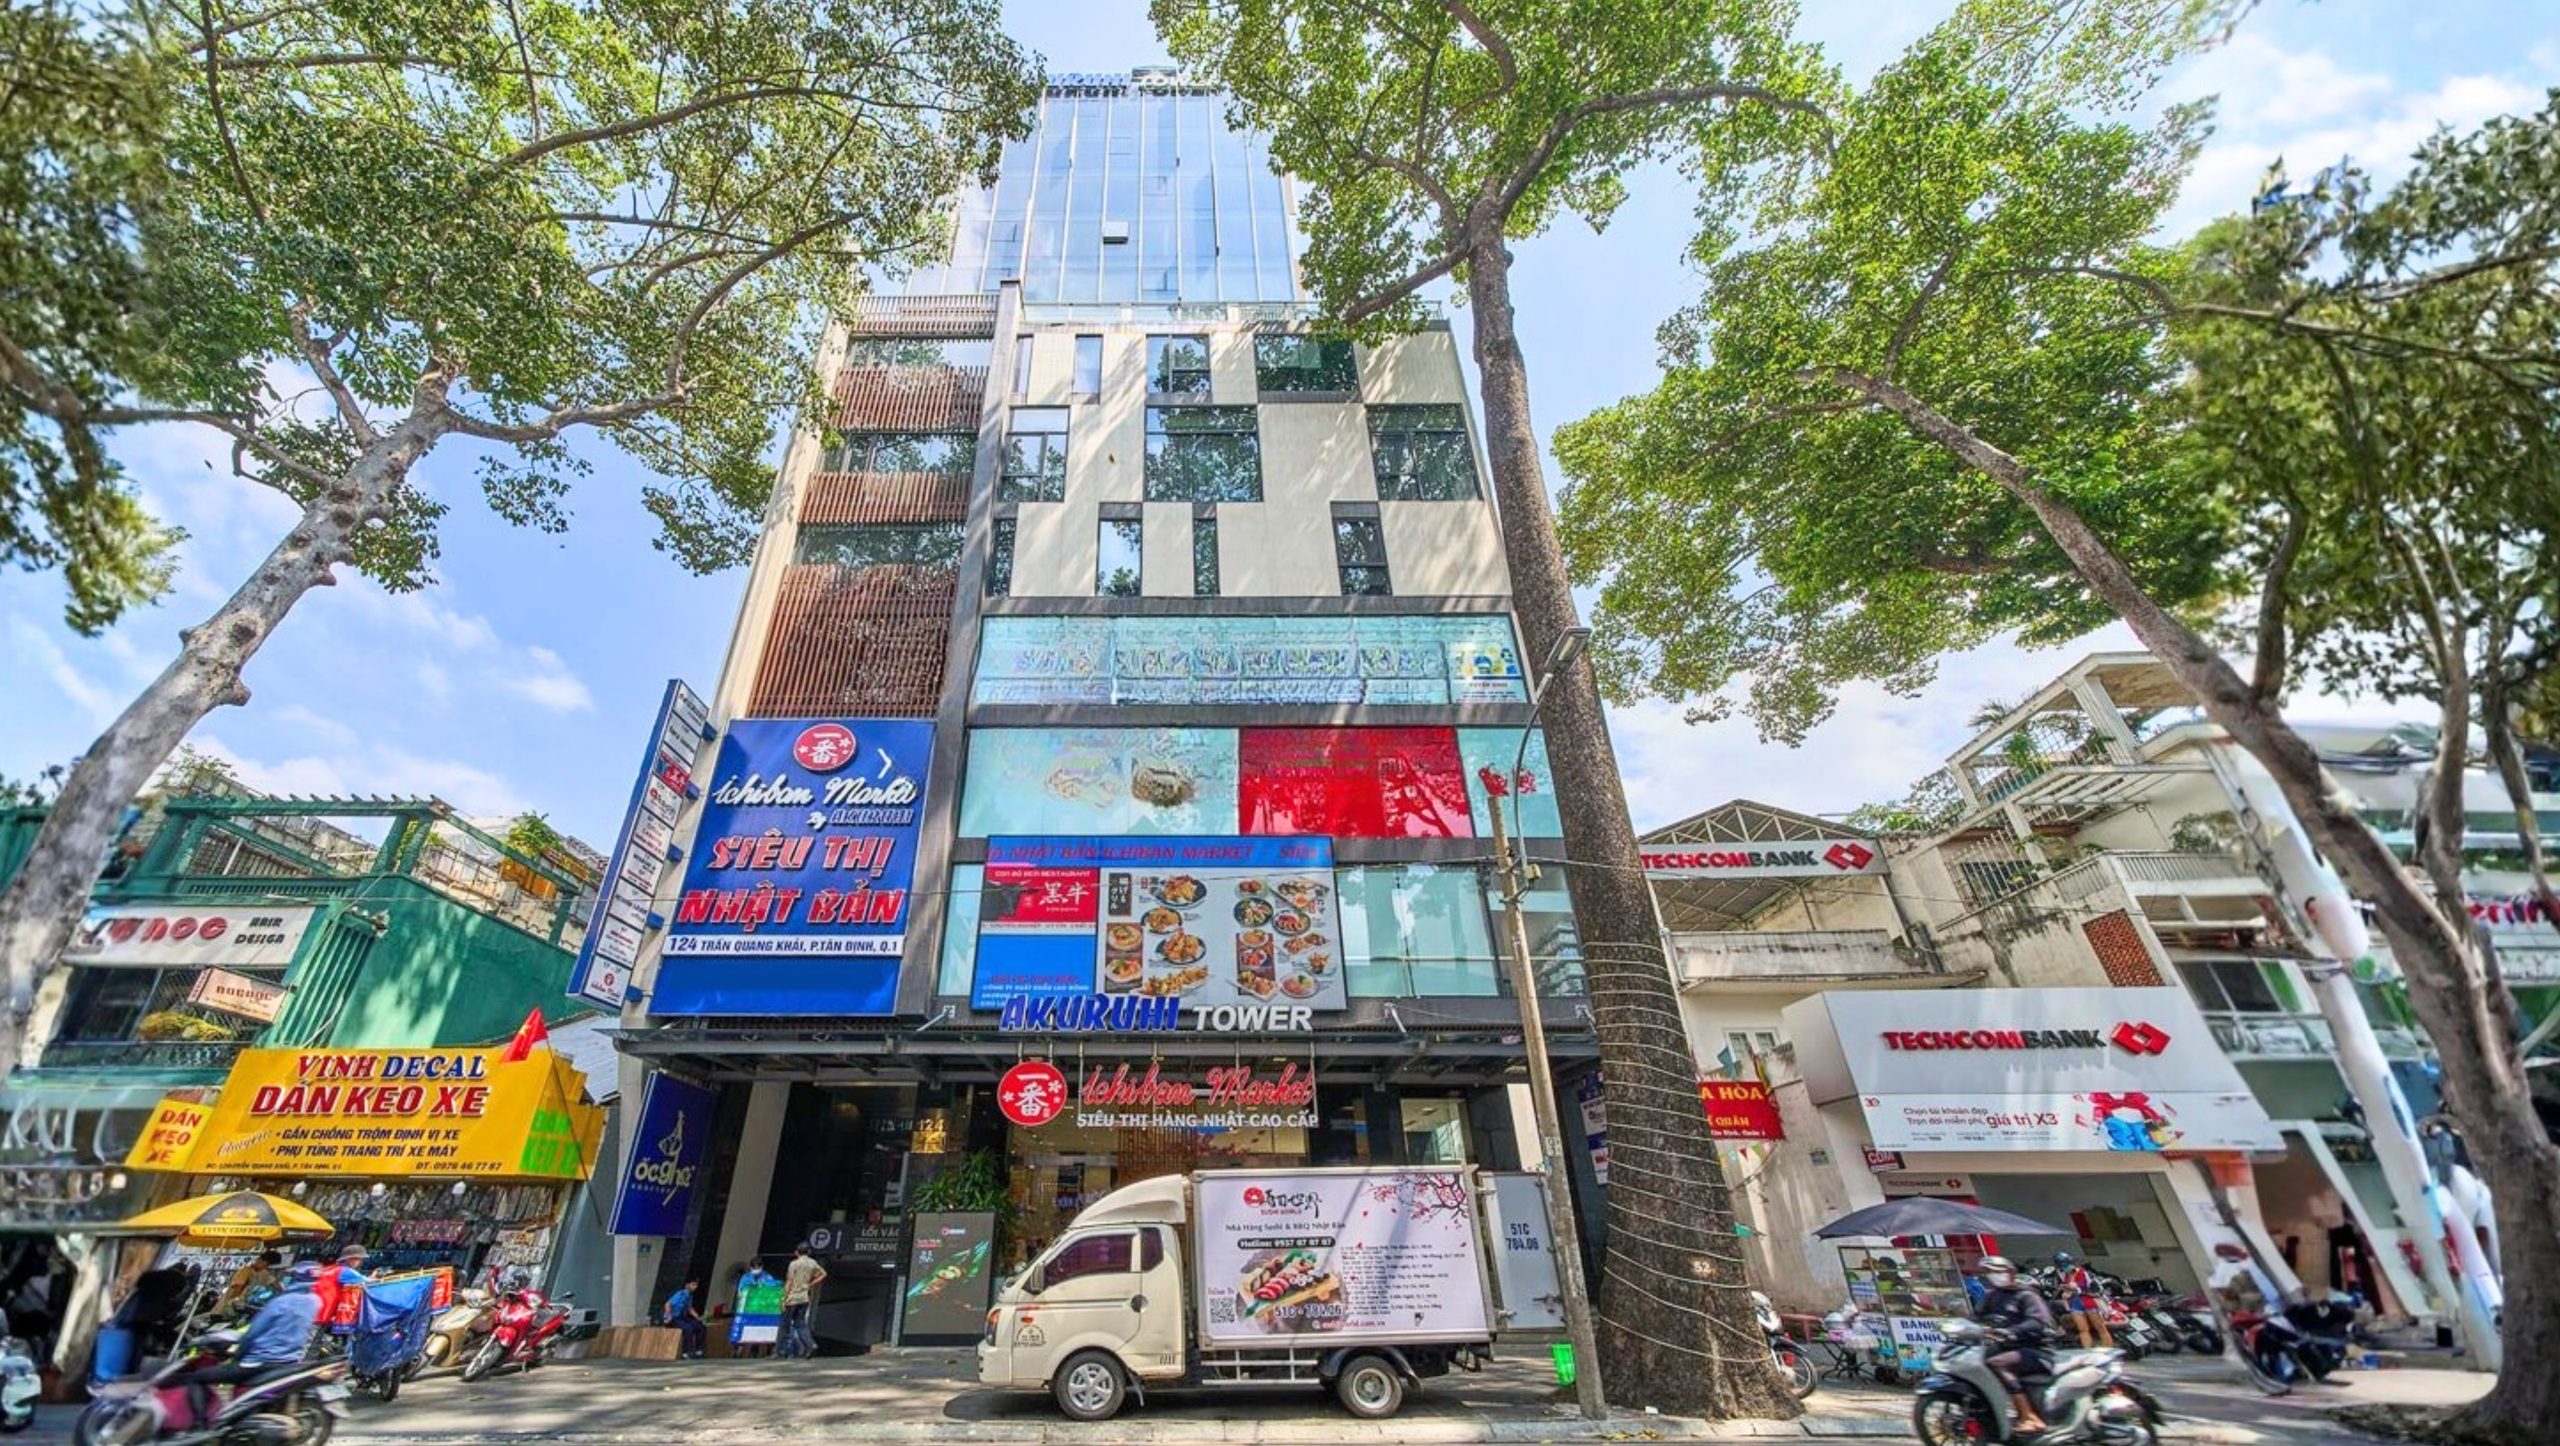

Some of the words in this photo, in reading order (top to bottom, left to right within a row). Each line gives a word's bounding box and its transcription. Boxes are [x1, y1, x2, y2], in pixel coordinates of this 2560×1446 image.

[707, 828, 814, 869] SIÊU
[824, 836, 896, 878] THỊ
[1641, 850, 1819, 869] TECHCOMBANK
[677, 879, 803, 933] NHẬT
[808, 879, 906, 924] BẢN
[235, 933, 285, 945] DESIGN
[669, 936, 698, 952] 124
[735, 941, 773, 952] QUANG
[880, 941, 897, 953] Q.1
[1001, 993, 1180, 1031] AKURUHI
[1193, 1004, 1313, 1032] TOWER
[1881, 1029, 2107, 1050] TECHCOMBANK
[298, 1055, 379, 1080] VINH
[381, 1055, 487, 1080] DECAL
[343, 1085, 425, 1117] KEO
[430, 1085, 491, 1117] XE
[1014, 1072, 1051, 1118] 一番
[1077, 1111, 1115, 1127] SIÊU
[1152, 1111, 1198, 1127] HÀNG
[1249, 1113, 1281, 1127] CAO
[1287, 1109, 1319, 1127] CẤP
[1986, 1113, 2012, 1129] giá
[2014, 1112, 2034, 1129] trị
[2036, 1112, 2059, 1126] X3
[152, 1129, 191, 1146] KEO
[442, 1129, 460, 1140] XE
[146, 1150, 175, 1164] XE
[340, 1145, 382, 1156] TRANG
[407, 1145, 425, 1156] XE
[428, 1143, 459, 1156] MÁY
[1510, 1223, 1530, 1236] 51C
[1274, 1305, 1297, 1318] 51C
